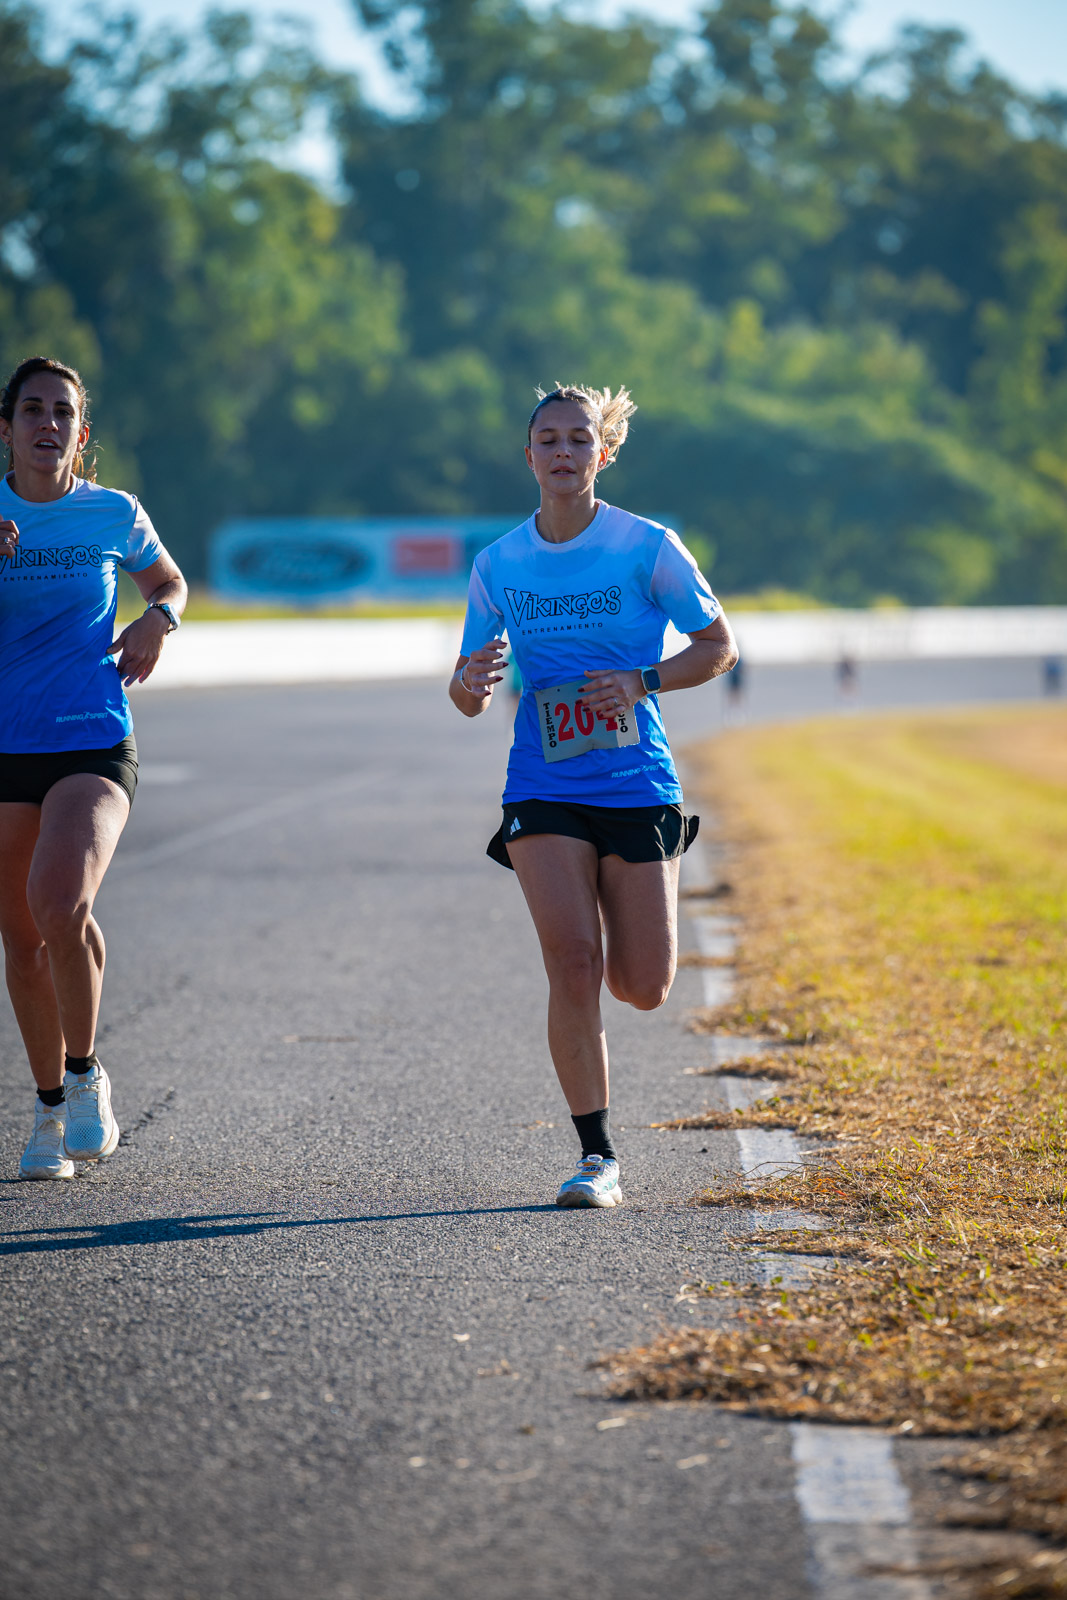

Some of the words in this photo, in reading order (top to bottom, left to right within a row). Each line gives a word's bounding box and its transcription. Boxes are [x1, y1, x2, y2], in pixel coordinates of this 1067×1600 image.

[4, 572, 88, 582] ENTRENAMIENTO
[522, 622, 603, 635] ENTRENAMIENTO
[543, 702, 557, 748] TIEMPO
[611, 767, 641, 778] RUNNING
